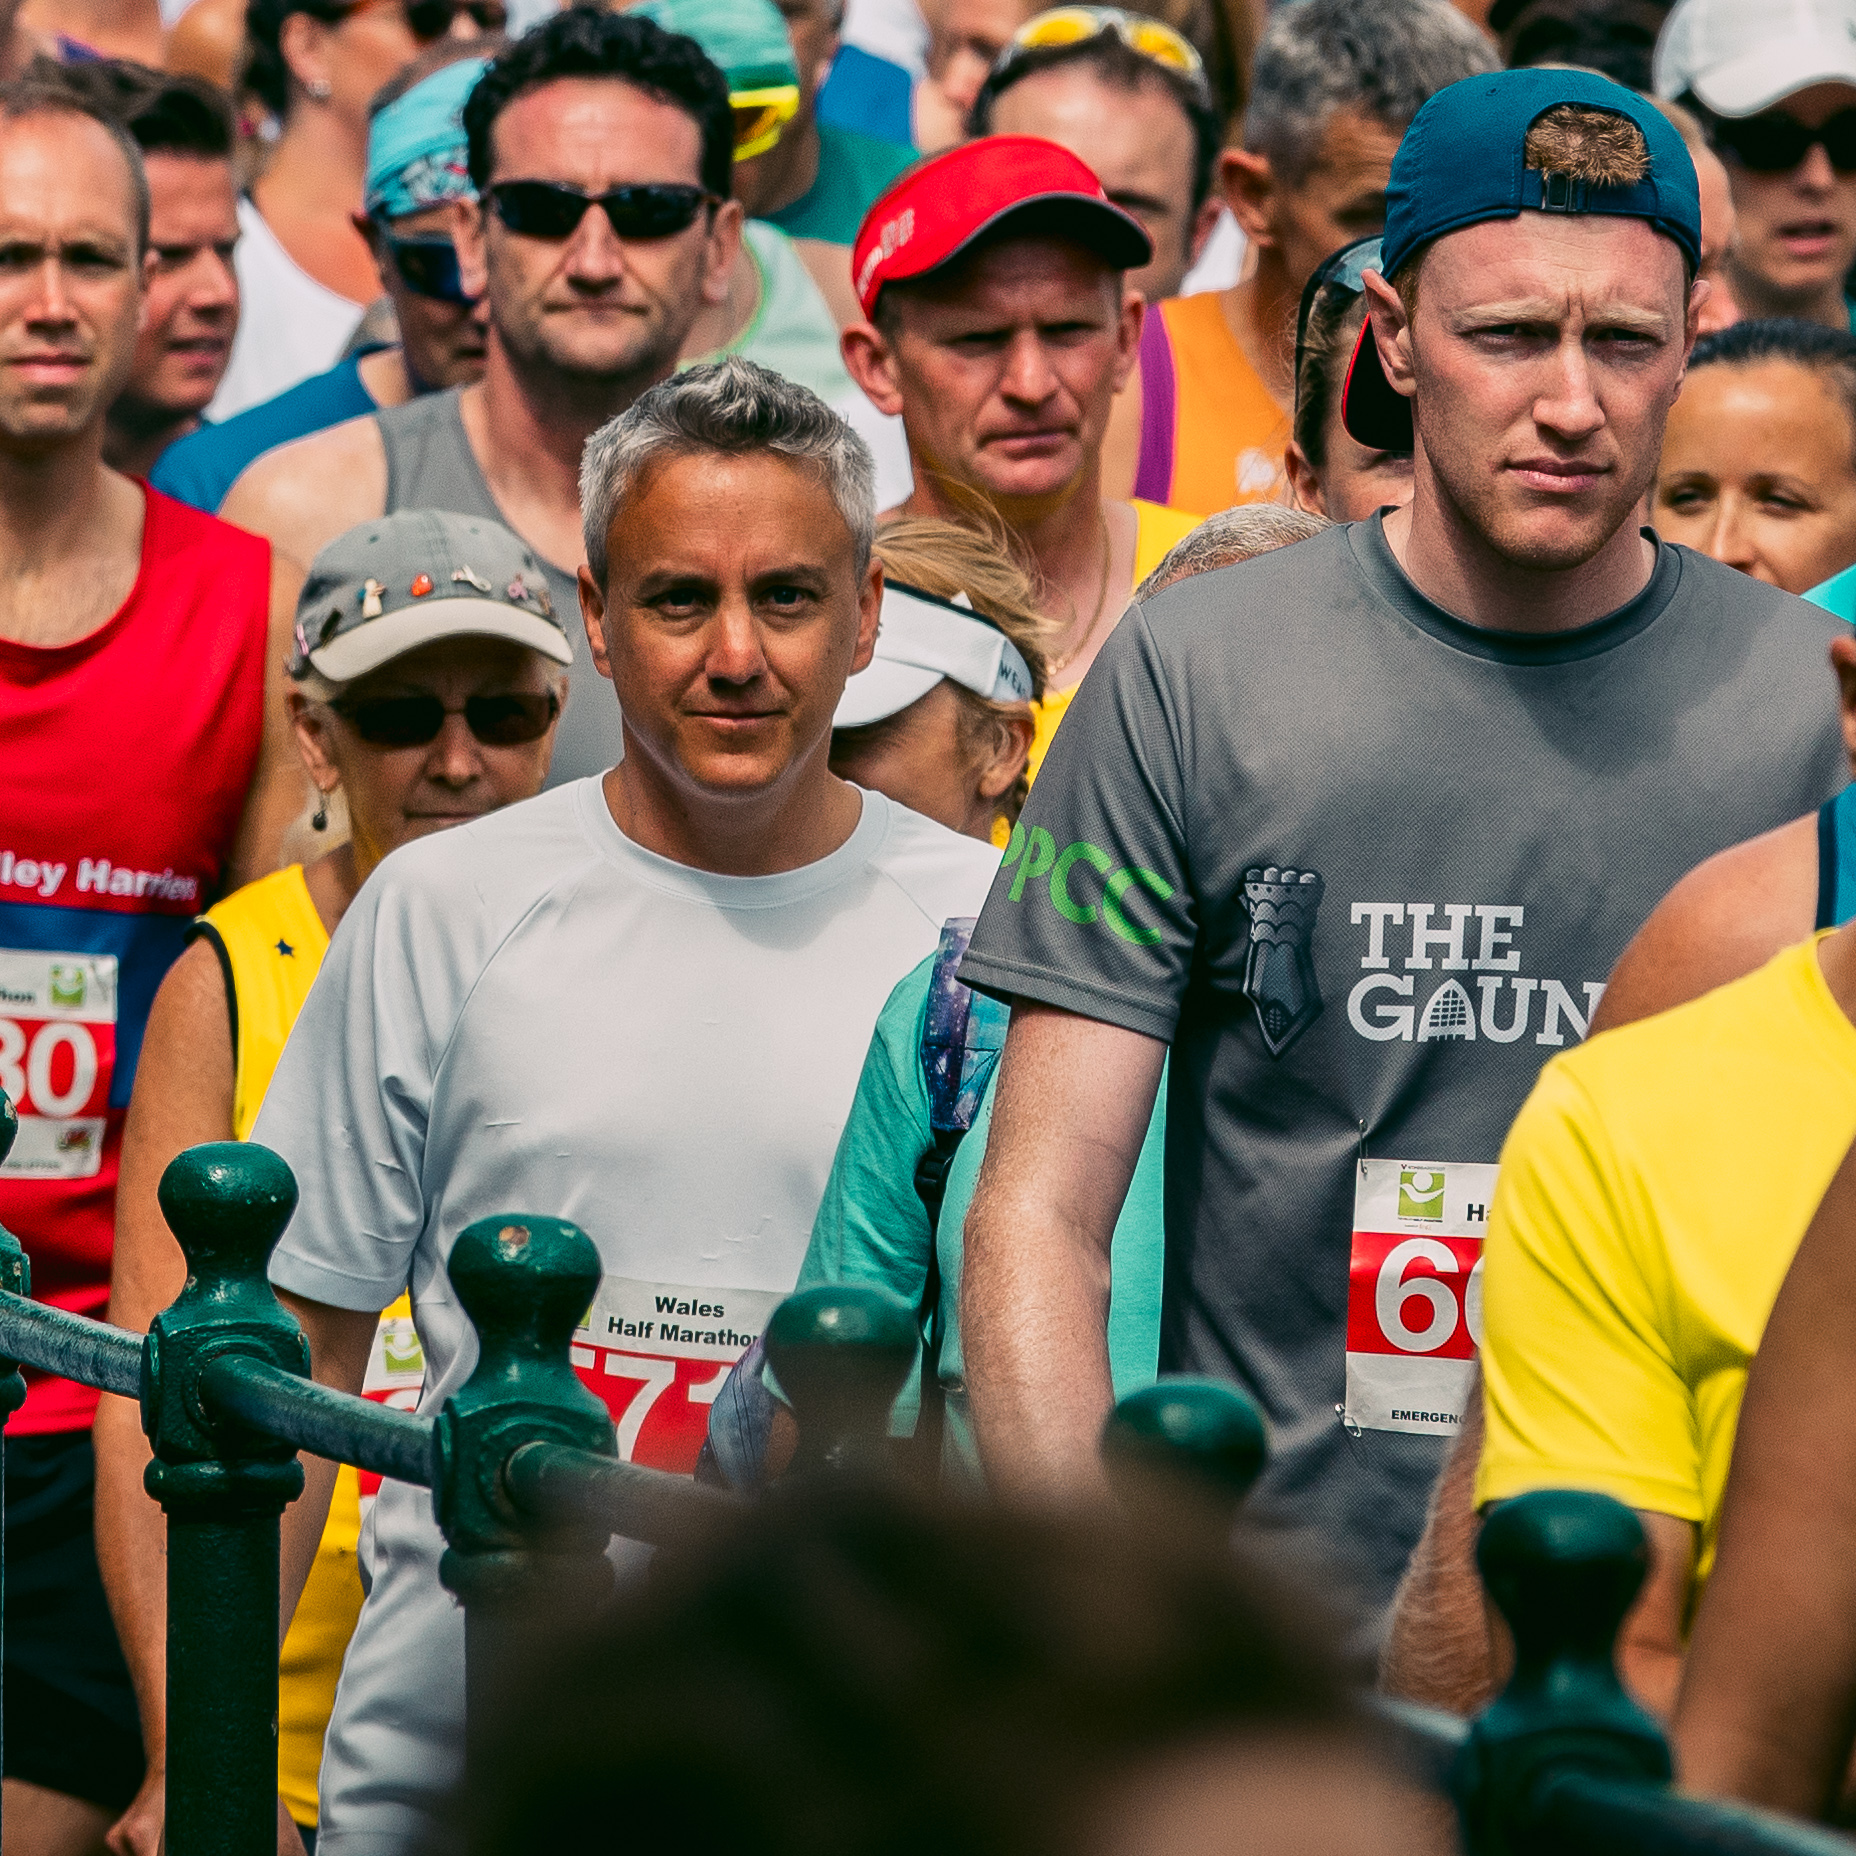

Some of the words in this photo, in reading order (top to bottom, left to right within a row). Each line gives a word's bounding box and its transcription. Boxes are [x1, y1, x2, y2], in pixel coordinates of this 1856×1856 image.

[1350, 902, 1524, 971] THE
[655, 1296, 724, 1318] Wales
[608, 1316, 654, 1339] Half
